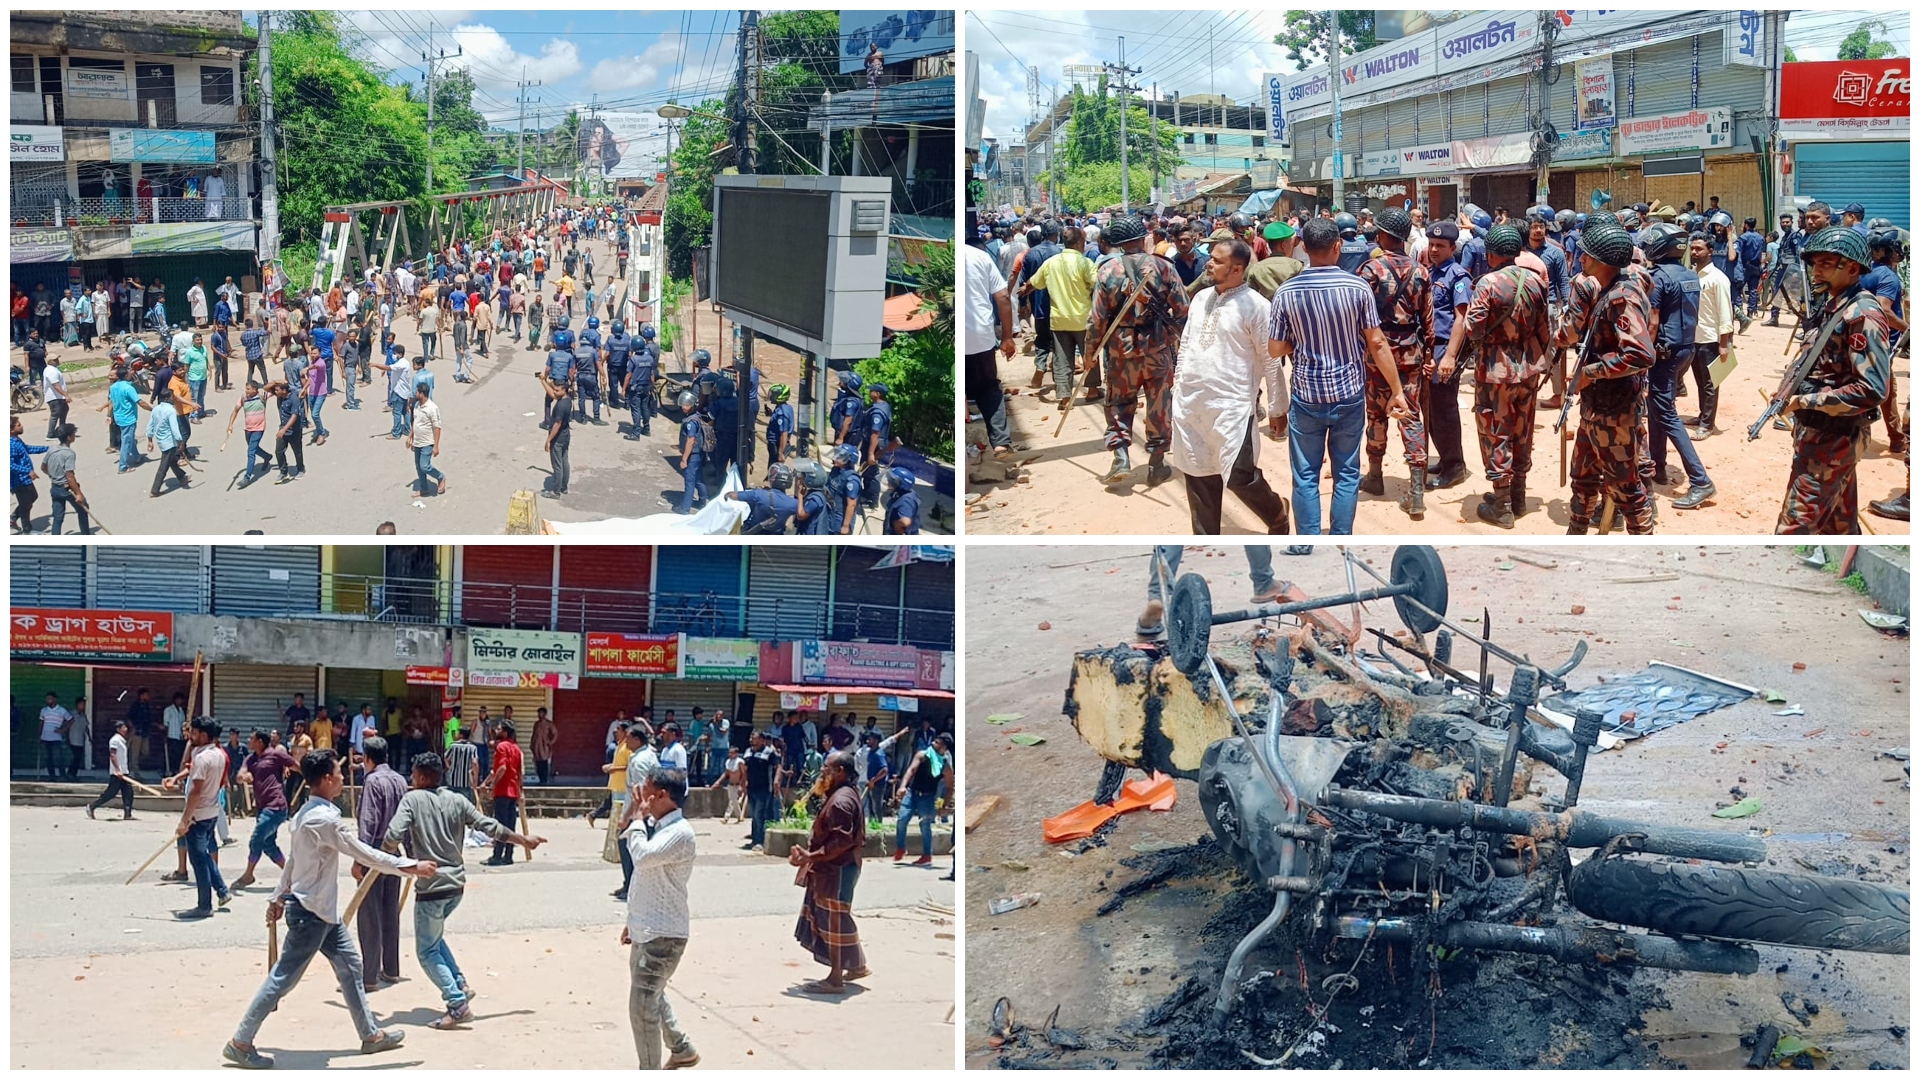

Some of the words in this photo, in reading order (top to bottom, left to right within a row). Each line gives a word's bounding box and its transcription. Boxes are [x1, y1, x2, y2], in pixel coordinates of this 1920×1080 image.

[1442, 20, 1516, 60] ওয়ালটন
[1074, 64, 1092, 73] HOTEL
[1366, 48, 1419, 78] WALTON
[1288, 76, 1328, 101] ওয়ালটন
[1270, 78, 1286, 140] ওয়ালটন
[1418, 148, 1450, 160] WALTON
[1426, 176, 1450, 184] WALTON
[10, 614, 40, 630] ক
[44, 616, 89, 634] ড্রাগ
[94, 615, 156, 634] হাউস
[472, 638, 518, 660] মিস্টার
[521, 644, 576, 662] মোবাইল
[588, 648, 624, 662] শাপলা
[626, 644, 666, 664] ফার্মেসী
[520, 672, 540, 688] ১৪
